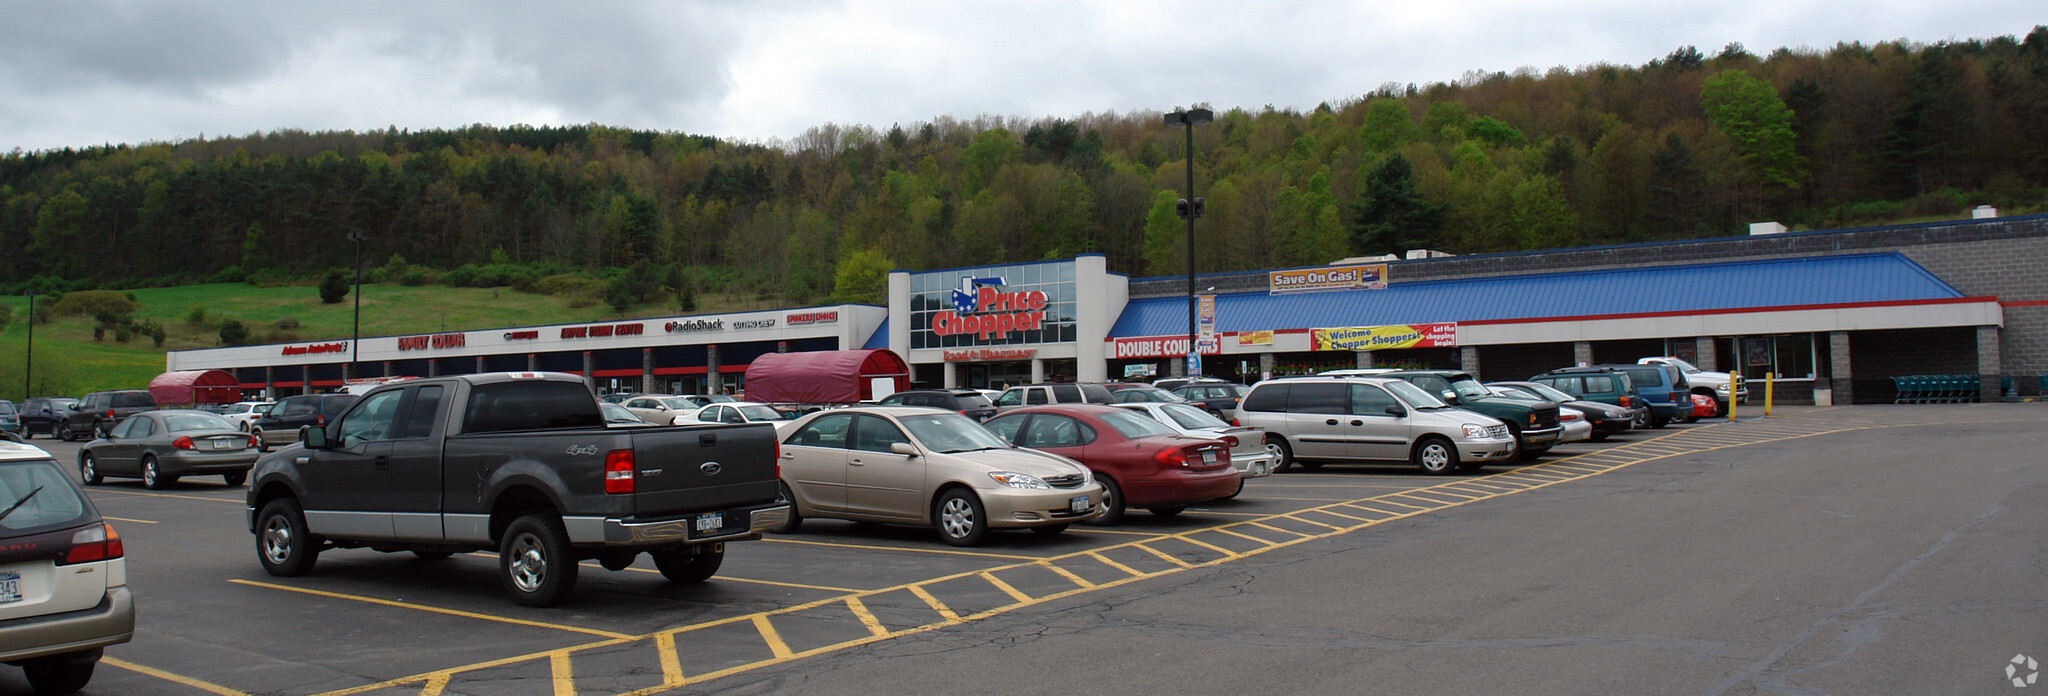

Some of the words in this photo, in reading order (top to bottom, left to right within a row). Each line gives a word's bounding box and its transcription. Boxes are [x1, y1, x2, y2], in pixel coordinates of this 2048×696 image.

[1274, 275, 1306, 286] Save
[1307, 272, 1327, 283] On
[1327, 269, 1358, 282] Gas!
[978, 287, 1047, 312] Price
[786, 313, 815, 325] SMOKERS
[815, 311, 838, 323] CHOICE
[932, 310, 1046, 340] Chopper
[614, 323, 644, 336] CENTER
[672, 318, 723, 333] RadioShack
[1330, 329, 1372, 340] Welcome
[1331, 340, 1370, 350] Chopper
[1371, 330, 1421, 345] Shoppers!
[1426, 333, 1455, 341] chopping
[398, 336, 430, 350] FAMILY
[1118, 340, 1162, 356] DOUBLE
[1163, 338, 1218, 355] COUONS
[1434, 339, 1455, 347] begin!
[943, 350, 970, 360] Food
[969, 350, 979, 358] &
[979, 348, 1037, 359] Pharmacy
[566, 444, 598, 456] 4x4
